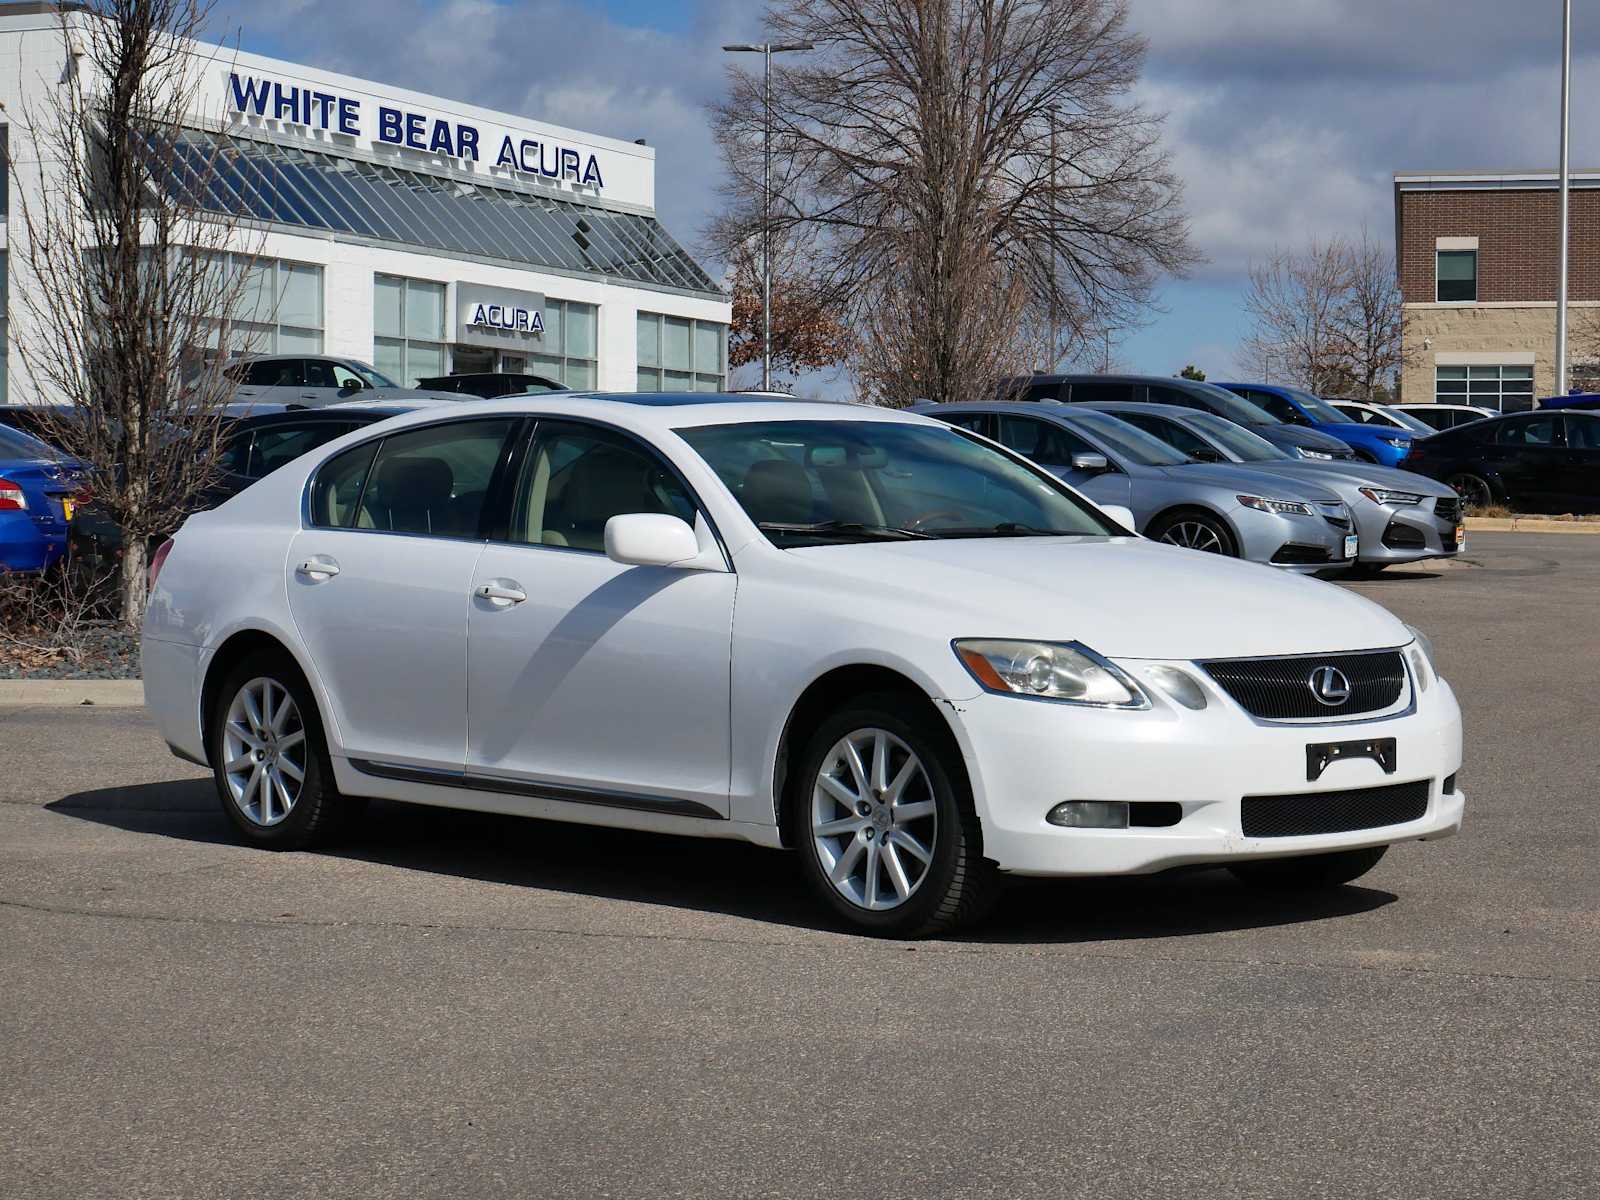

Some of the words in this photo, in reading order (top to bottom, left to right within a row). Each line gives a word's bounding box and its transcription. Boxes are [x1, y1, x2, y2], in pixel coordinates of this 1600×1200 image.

[230, 73, 361, 137] WHITE
[379, 106, 480, 162] BEAR
[496, 135, 605, 188] ACURA
[473, 304, 545, 333] ACURA
